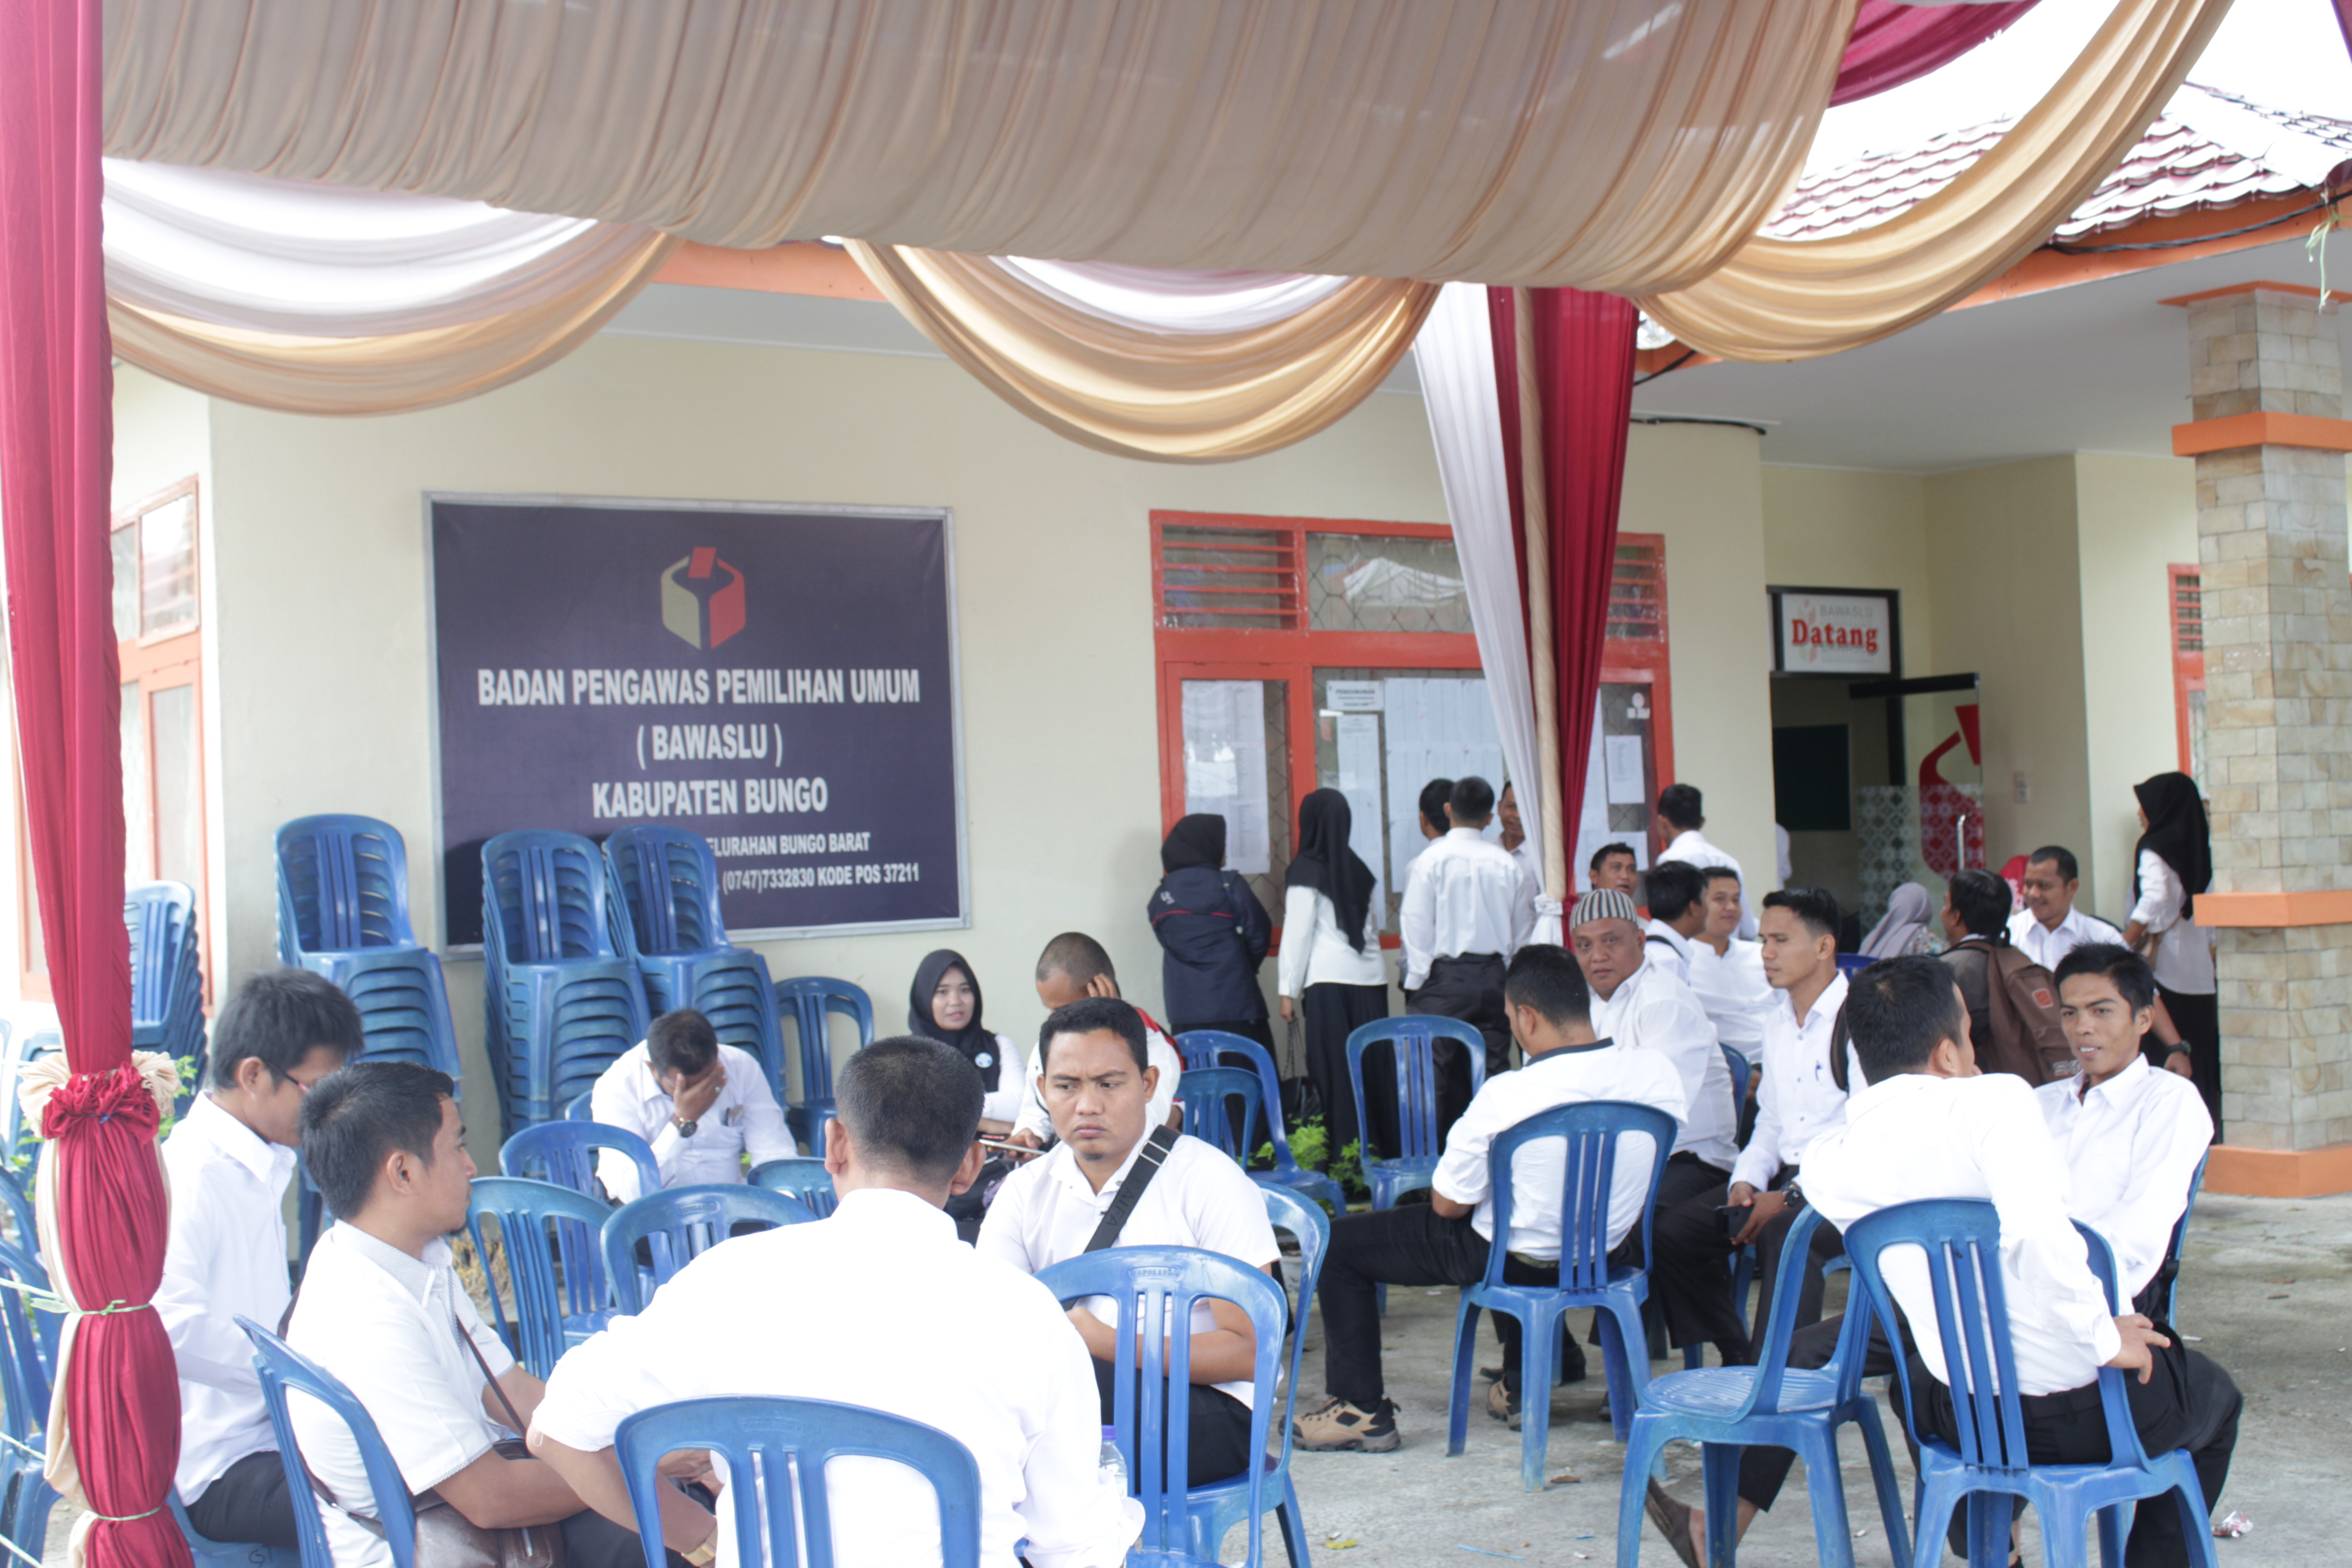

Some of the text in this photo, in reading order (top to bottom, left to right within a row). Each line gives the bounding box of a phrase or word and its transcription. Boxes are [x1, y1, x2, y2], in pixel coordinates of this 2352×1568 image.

[1791, 619, 1878, 653] Datang
[478, 668, 920, 706] BADAN PENGAWAS PEMILIHAN UMUM
[652, 724, 768, 760] BAWASLU
[592, 777, 828, 818] KABUPATEN BUNGO
[779, 833, 826, 855] BUNGO
[828, 832, 871, 853] BARAT
[722, 862, 919, 895] (0747)7332830 KODE POS 37211
